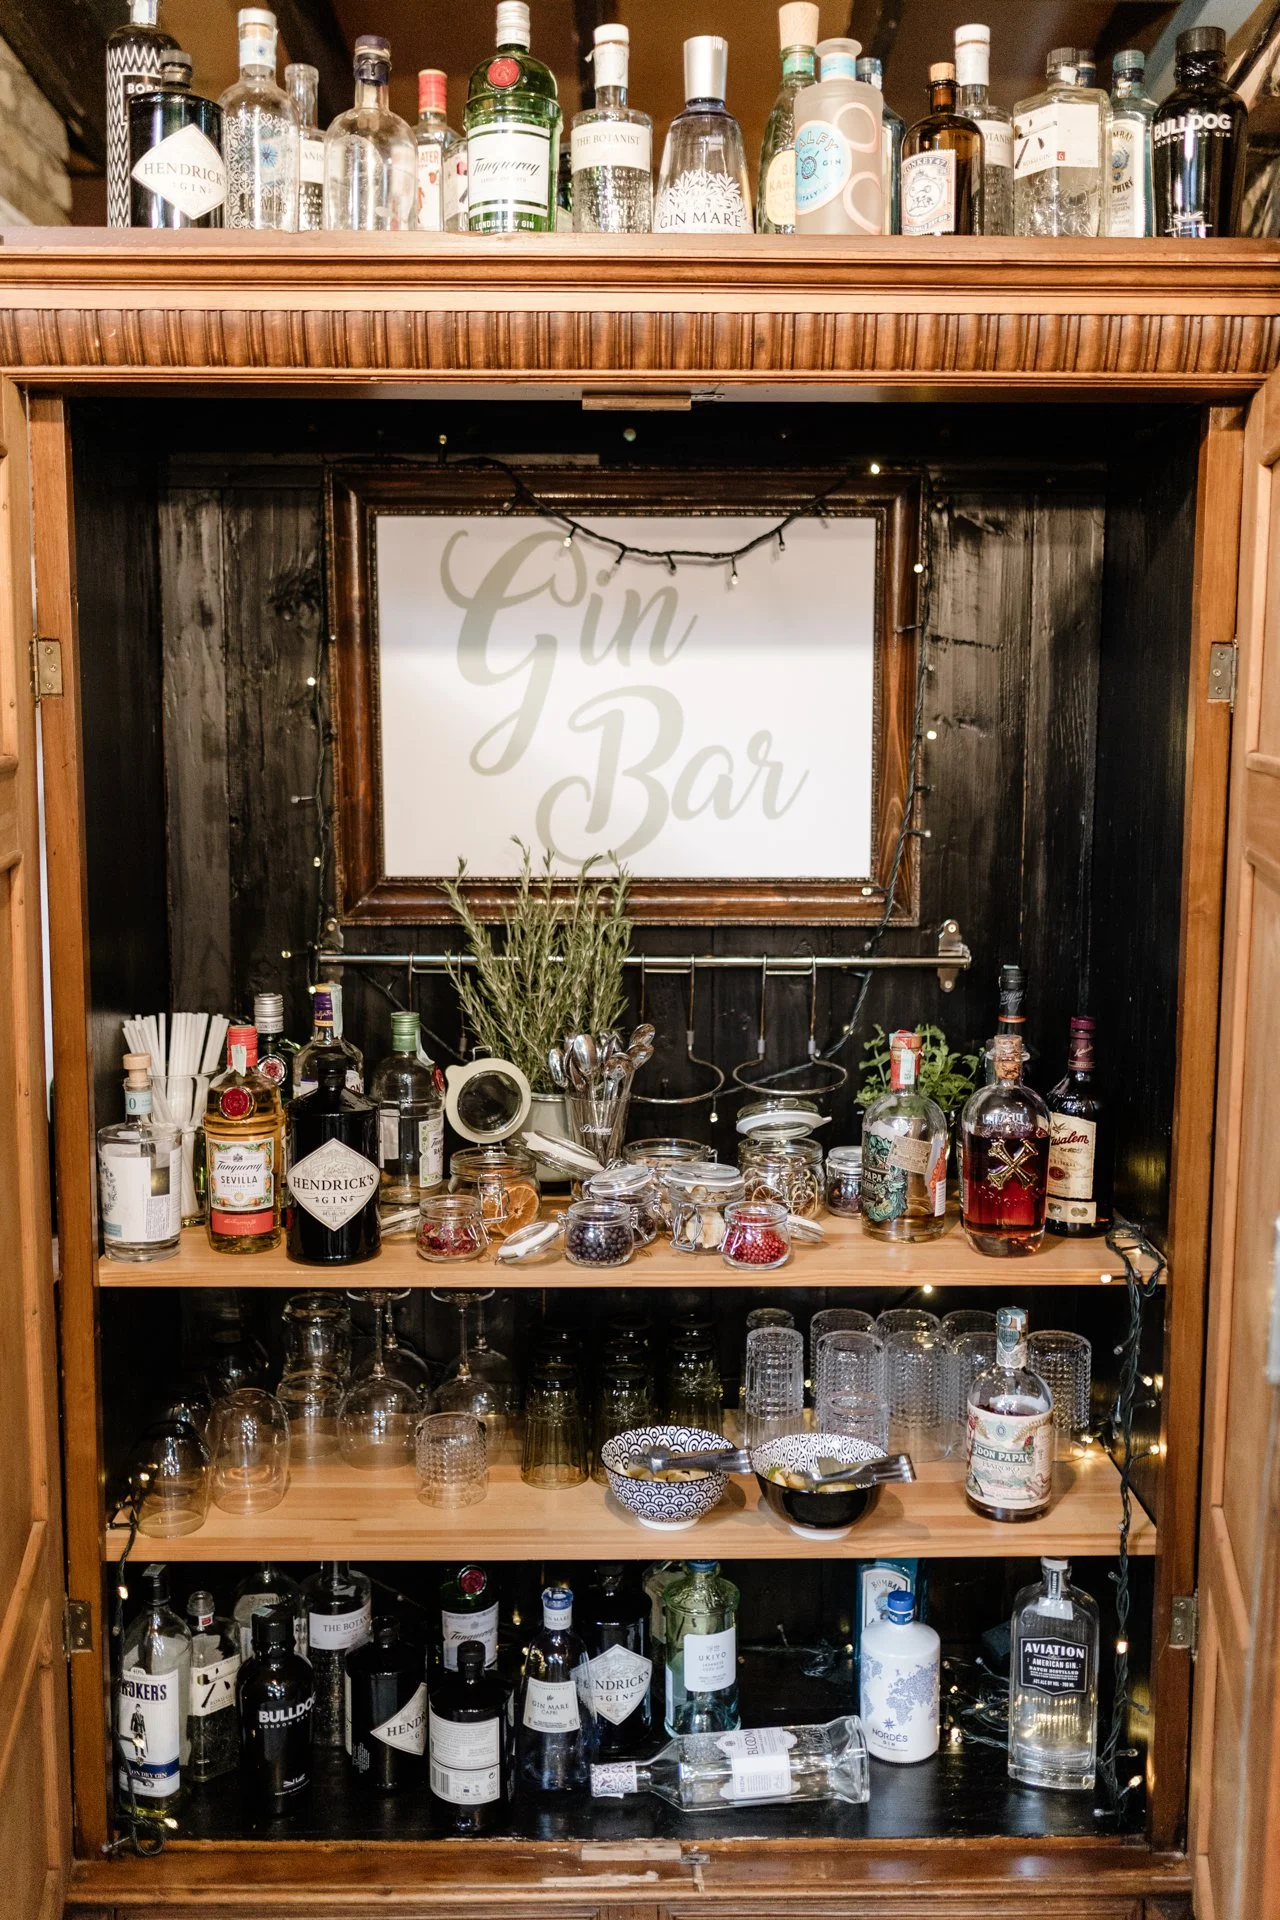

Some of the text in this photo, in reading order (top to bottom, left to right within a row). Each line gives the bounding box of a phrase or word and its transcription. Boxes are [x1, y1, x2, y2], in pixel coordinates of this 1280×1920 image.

[1154, 113, 1232, 142] BULLDOG
[593, 133, 641, 147] BOTANIST
[660, 212, 687, 229] GIN
[440, 528, 698, 778] Gin
[534, 684, 811, 868] Bar
[217, 1160, 262, 1173] Tanqueray
[220, 1175, 258, 1184] SEVILLA
[293, 1174, 375, 1191] HENDRICK'S
[321, 1195, 348, 1204] GIN
[976, 1445, 1025, 1463] DON PAPA
[323, 1624, 341, 1632] THE
[698, 1651, 727, 1661] UKIYO
[1024, 1642, 1086, 1659] AVIATION
[1032, 1657, 1064, 1669] AMERICAN
[119, 1680, 167, 1701] ROKER'S
[259, 1721, 293, 1729] LONDON
